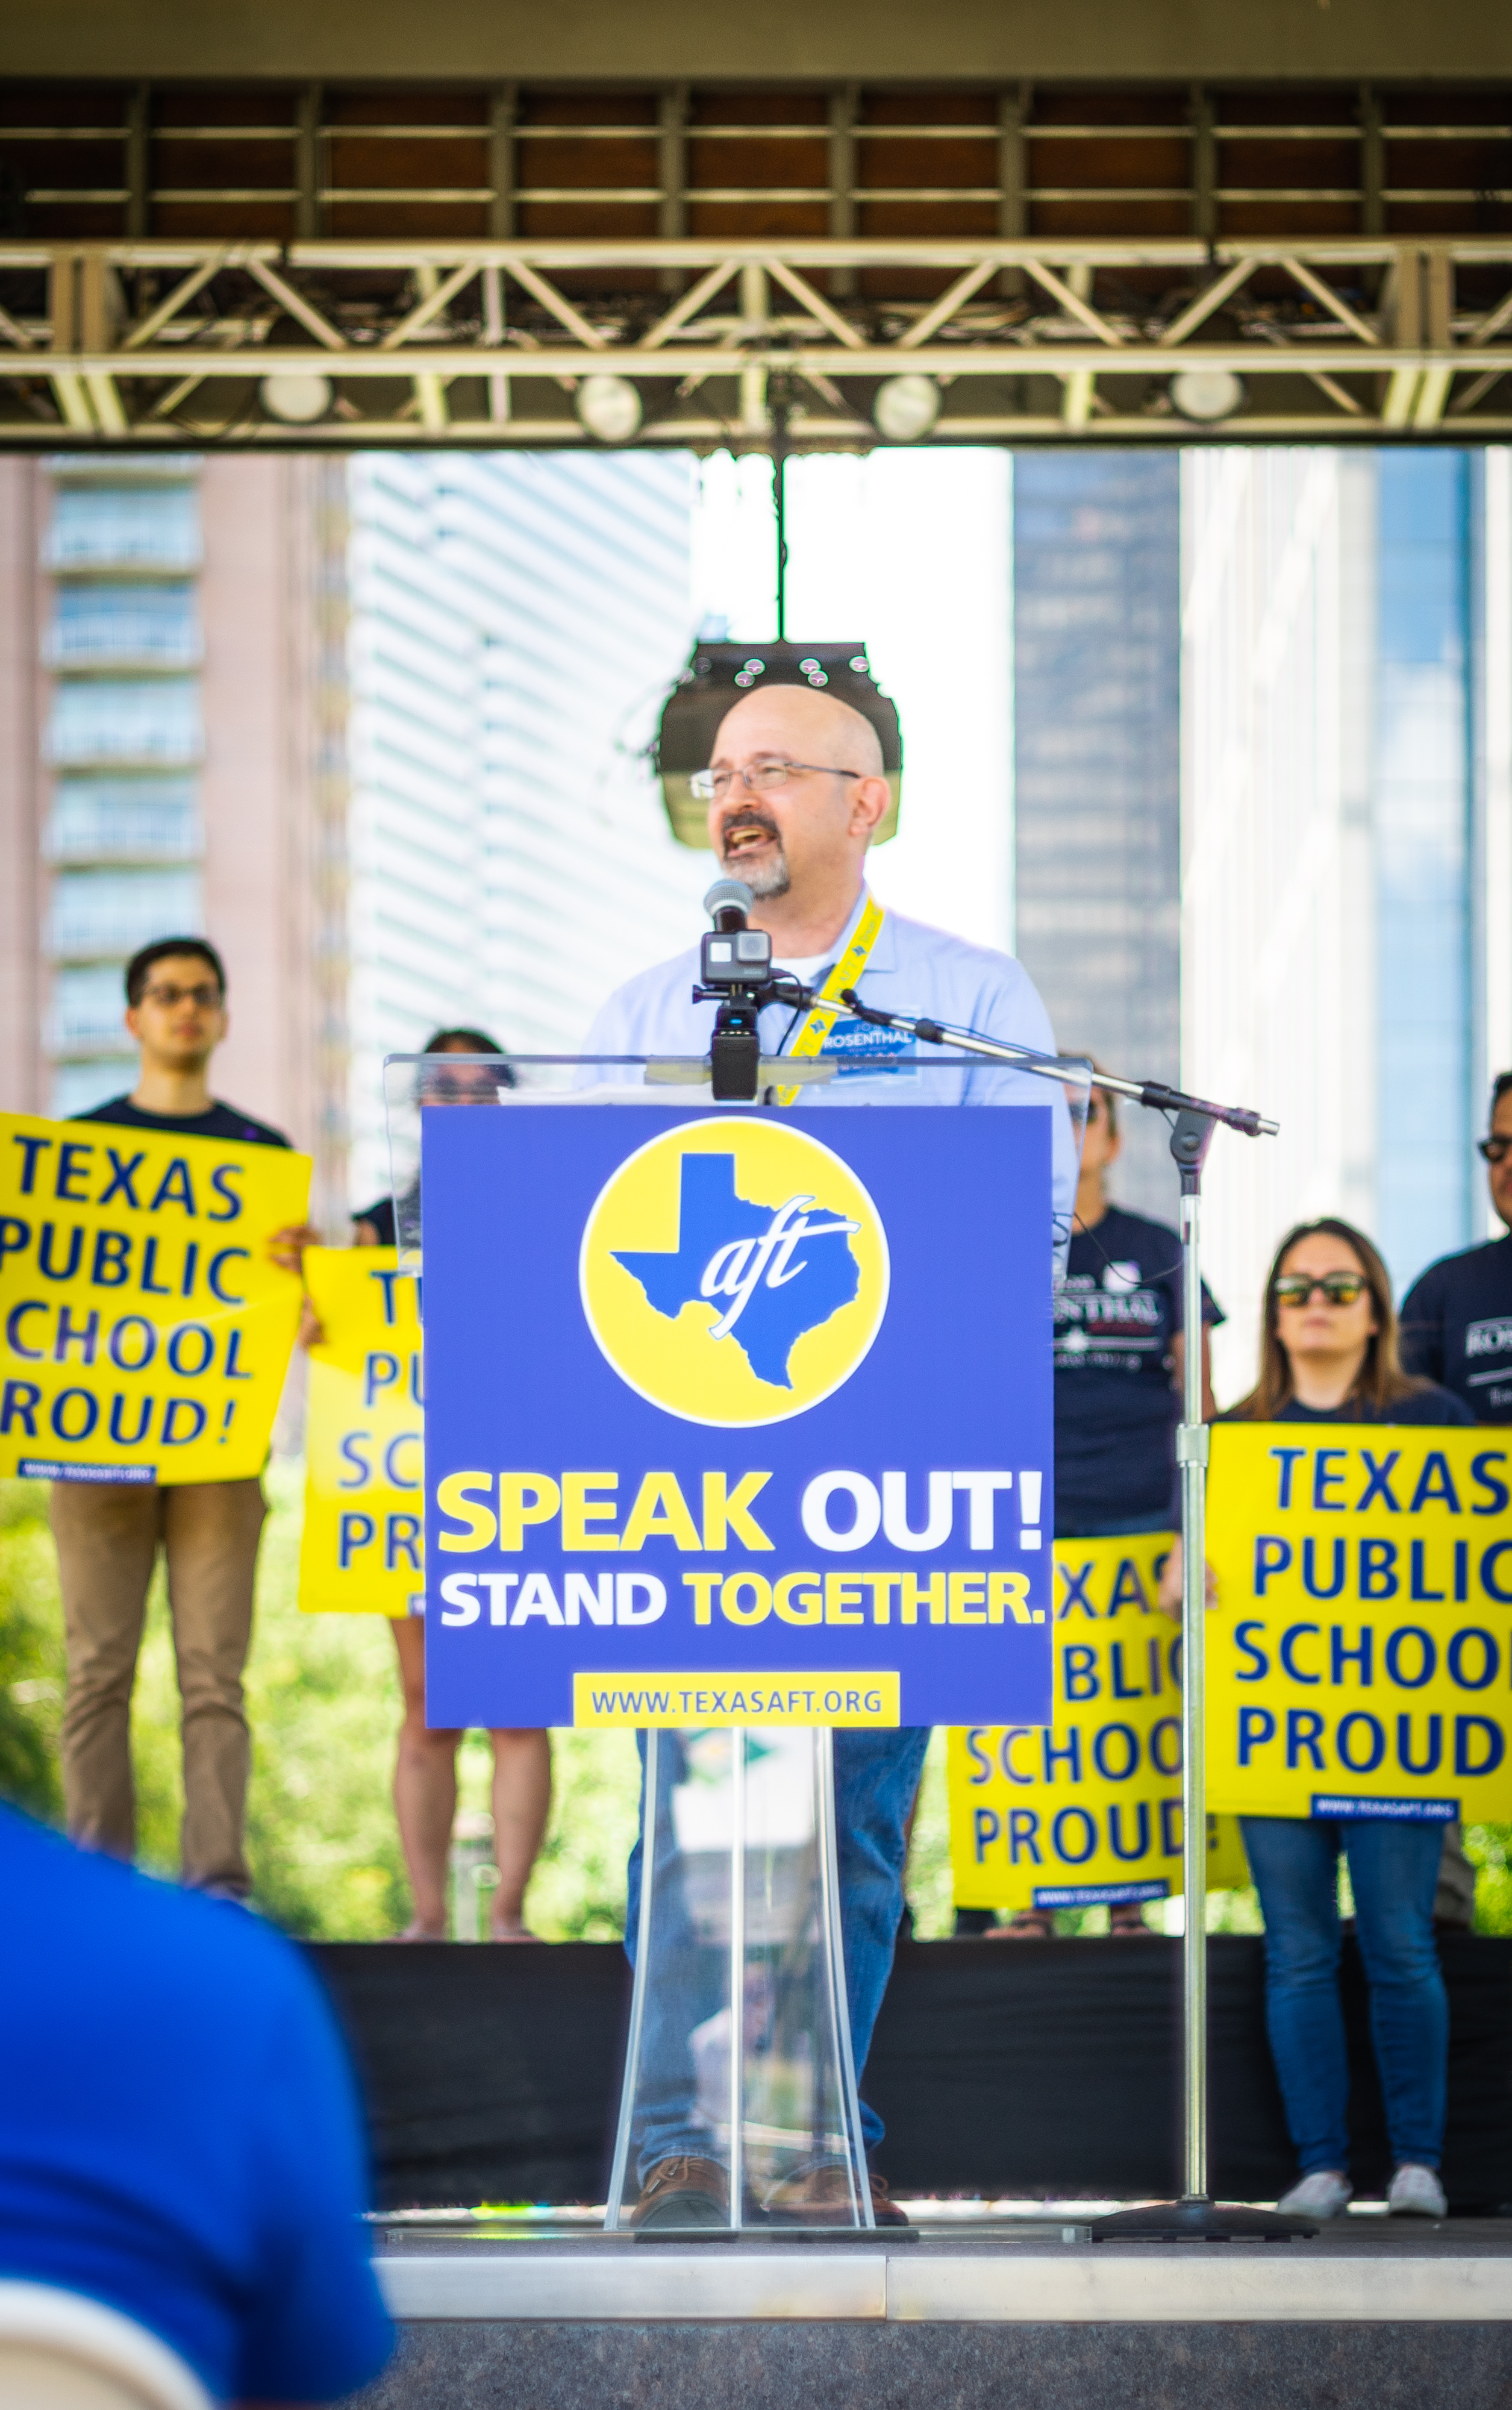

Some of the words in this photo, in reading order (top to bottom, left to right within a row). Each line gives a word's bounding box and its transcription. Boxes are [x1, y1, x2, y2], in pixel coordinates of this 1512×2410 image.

[823, 1030, 912, 1049] ROSENTHAL
[13, 1135, 244, 1222] TEXAS
[0, 1214, 251, 1306] PUBLIC
[701, 1195, 861, 1341] aft
[6, 1300, 253, 1380] CHOOL
[0, 1379, 237, 1446] ROUD!
[437, 1470, 775, 1552] SPEAK
[801, 1470, 1043, 1551] OUT!
[1269, 1447, 1510, 1515] TEXAS
[440, 1573, 667, 1626] STAND
[683, 1573, 1046, 1625] TOGETHER.
[1254, 1535, 1512, 1604] PUBLIC
[1235, 1620, 1512, 1691] SCHOO
[592, 1690, 882, 1714] WWW.TEXASAFT.ORG
[1238, 1706, 1506, 1776] PROUD
